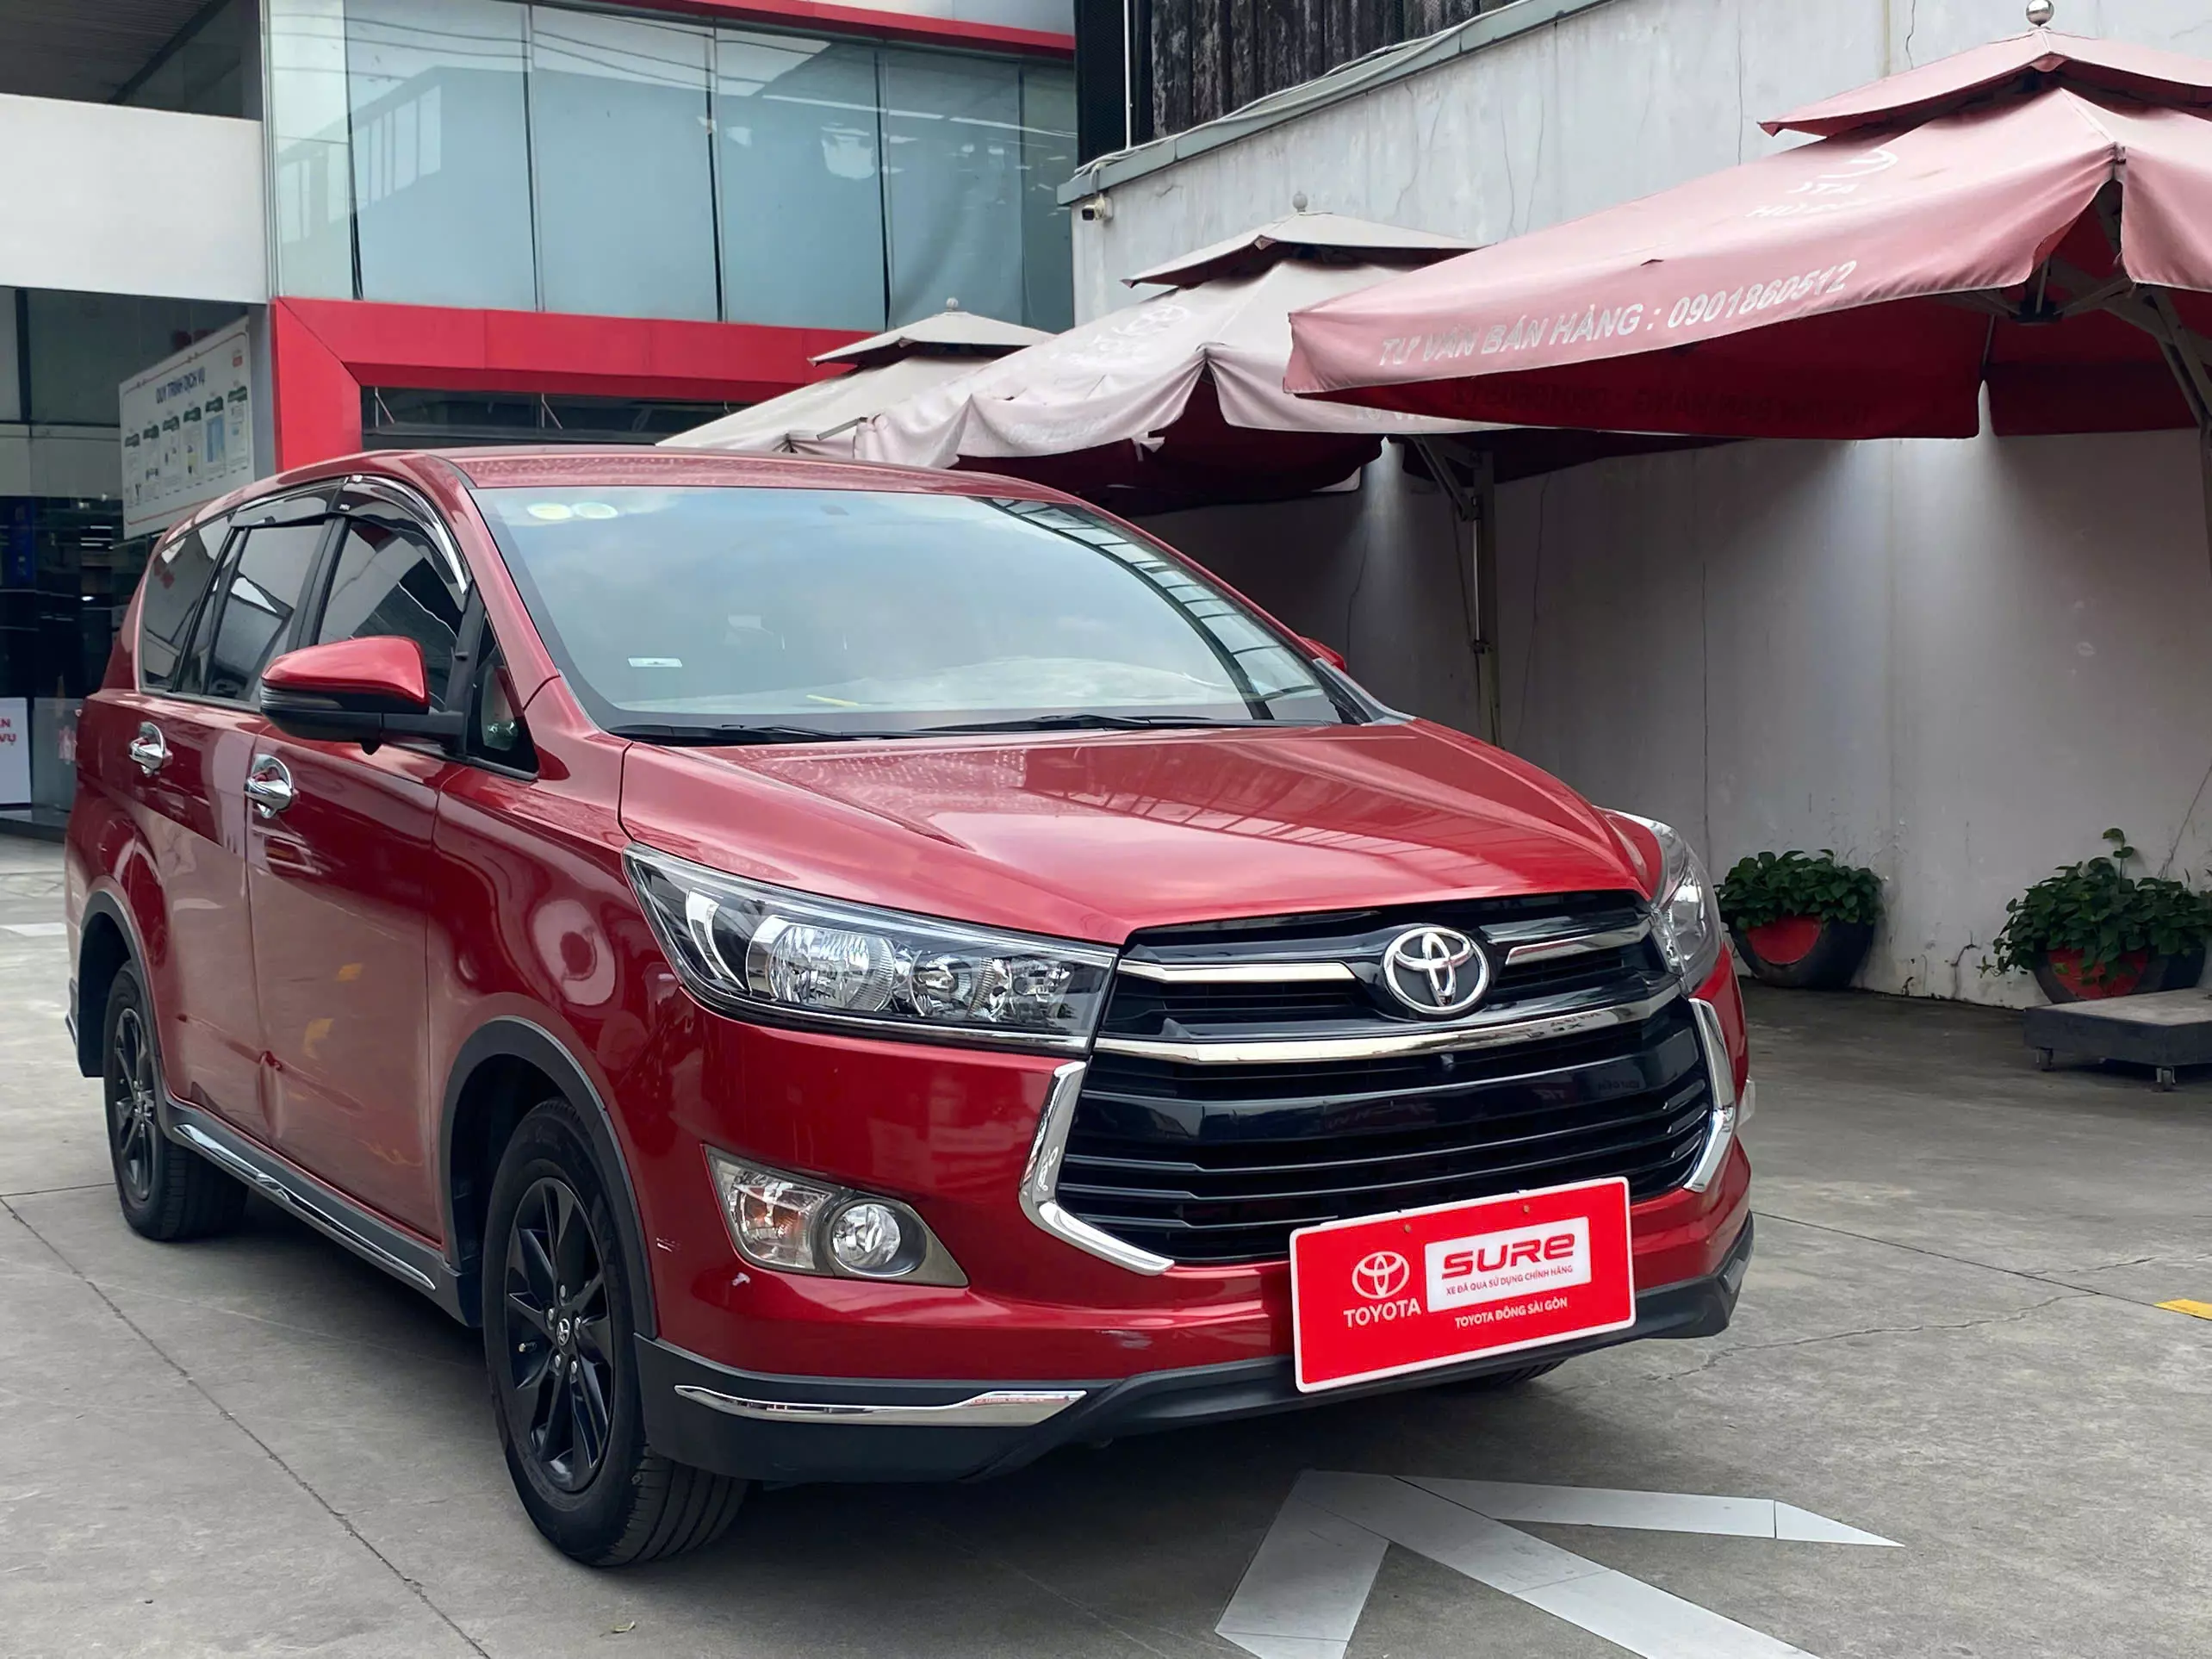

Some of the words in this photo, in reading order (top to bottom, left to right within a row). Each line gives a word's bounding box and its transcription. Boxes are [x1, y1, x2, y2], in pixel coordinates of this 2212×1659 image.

[1480, 314, 1549, 355] BÁN
[1549, 303, 1644, 345] HÀNG
[1667, 260, 1857, 328] 0901860512
[1445, 1285, 1457, 1296] XE
[1469, 1280, 1488, 1292] QUA
[1501, 1273, 1524, 1287] DỤNG
[1524, 1269, 1550, 1282] CHÍNH
[1343, 1297, 1422, 1329] TOYOTA
[1454, 1312, 1494, 1329] TOYOTA
[1494, 1305, 1527, 1320] ĐÔNG
[1527, 1300, 1544, 1314] SÀI
[1544, 1296, 1569, 1311] GÒN
